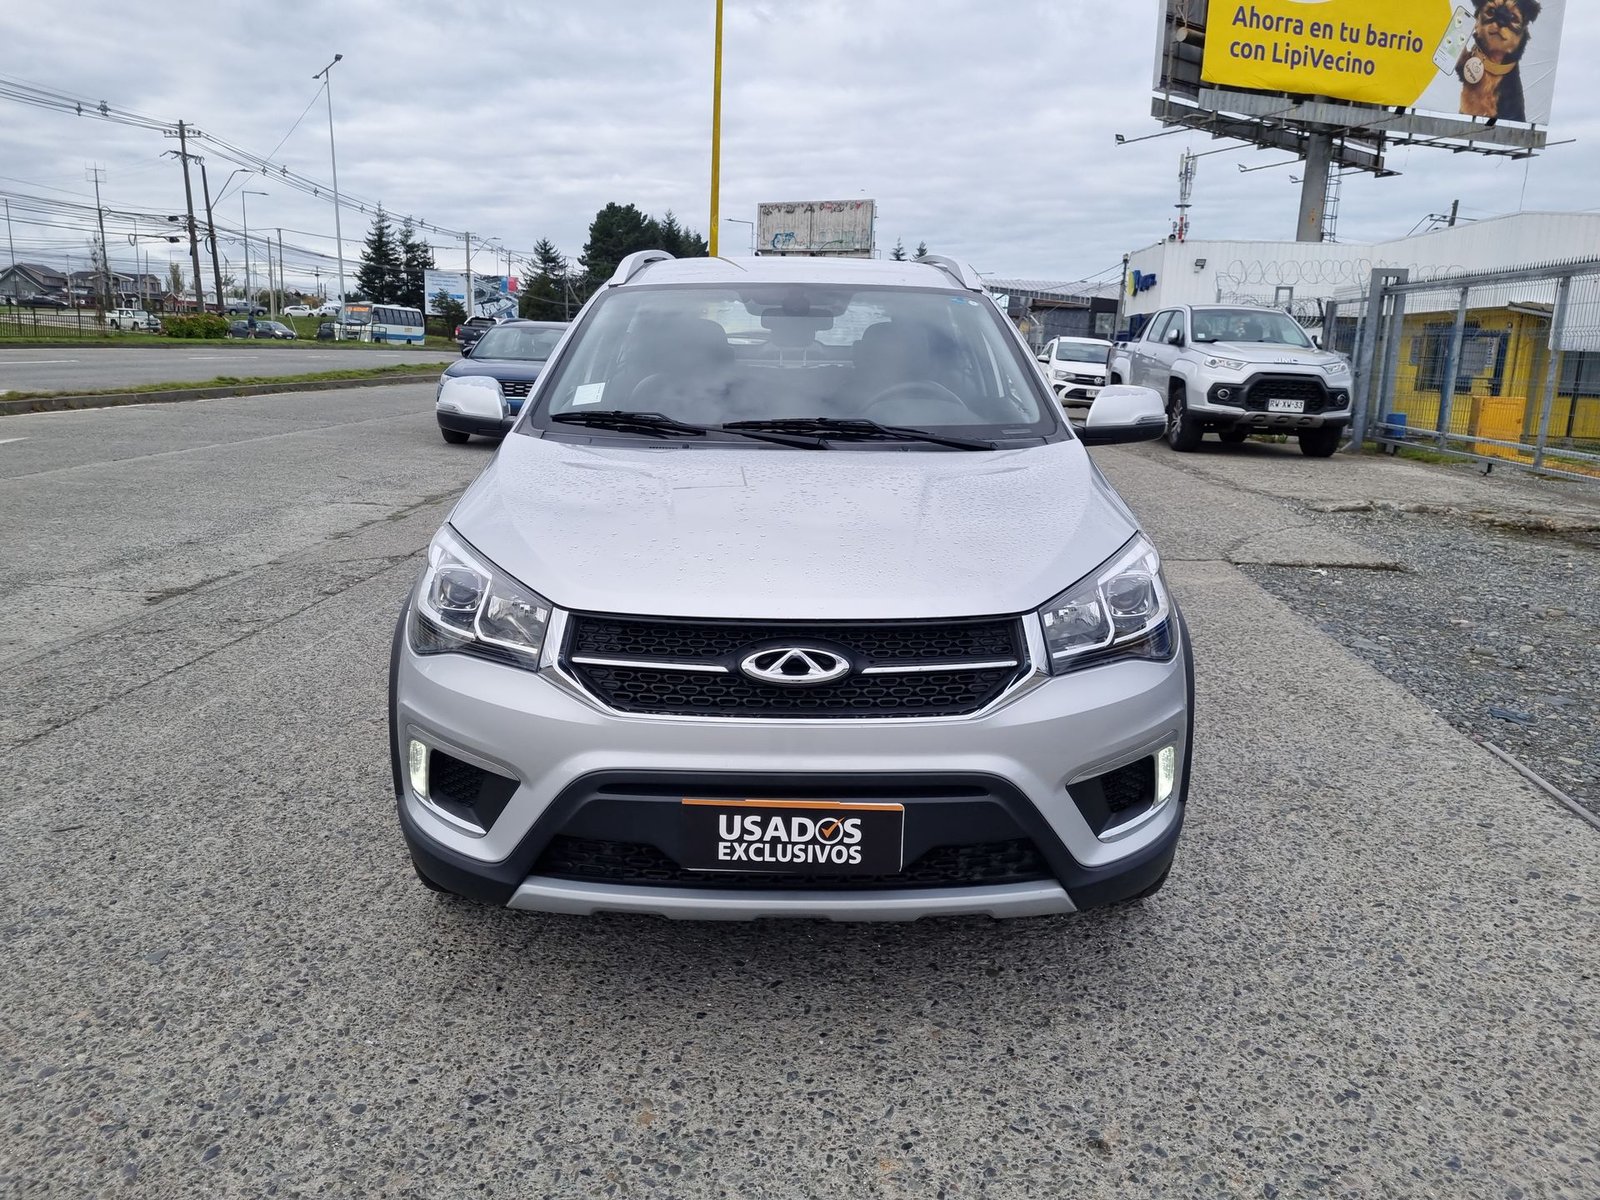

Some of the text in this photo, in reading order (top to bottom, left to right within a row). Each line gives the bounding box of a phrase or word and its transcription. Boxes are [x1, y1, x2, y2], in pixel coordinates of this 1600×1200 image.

[1232, 5, 1424, 54] Ahorra en tu barrio
[1230, 40, 1376, 76] con LipiVecino
[718, 814, 862, 845] USADOS
[718, 842, 862, 865] EXCLUSIVOS
